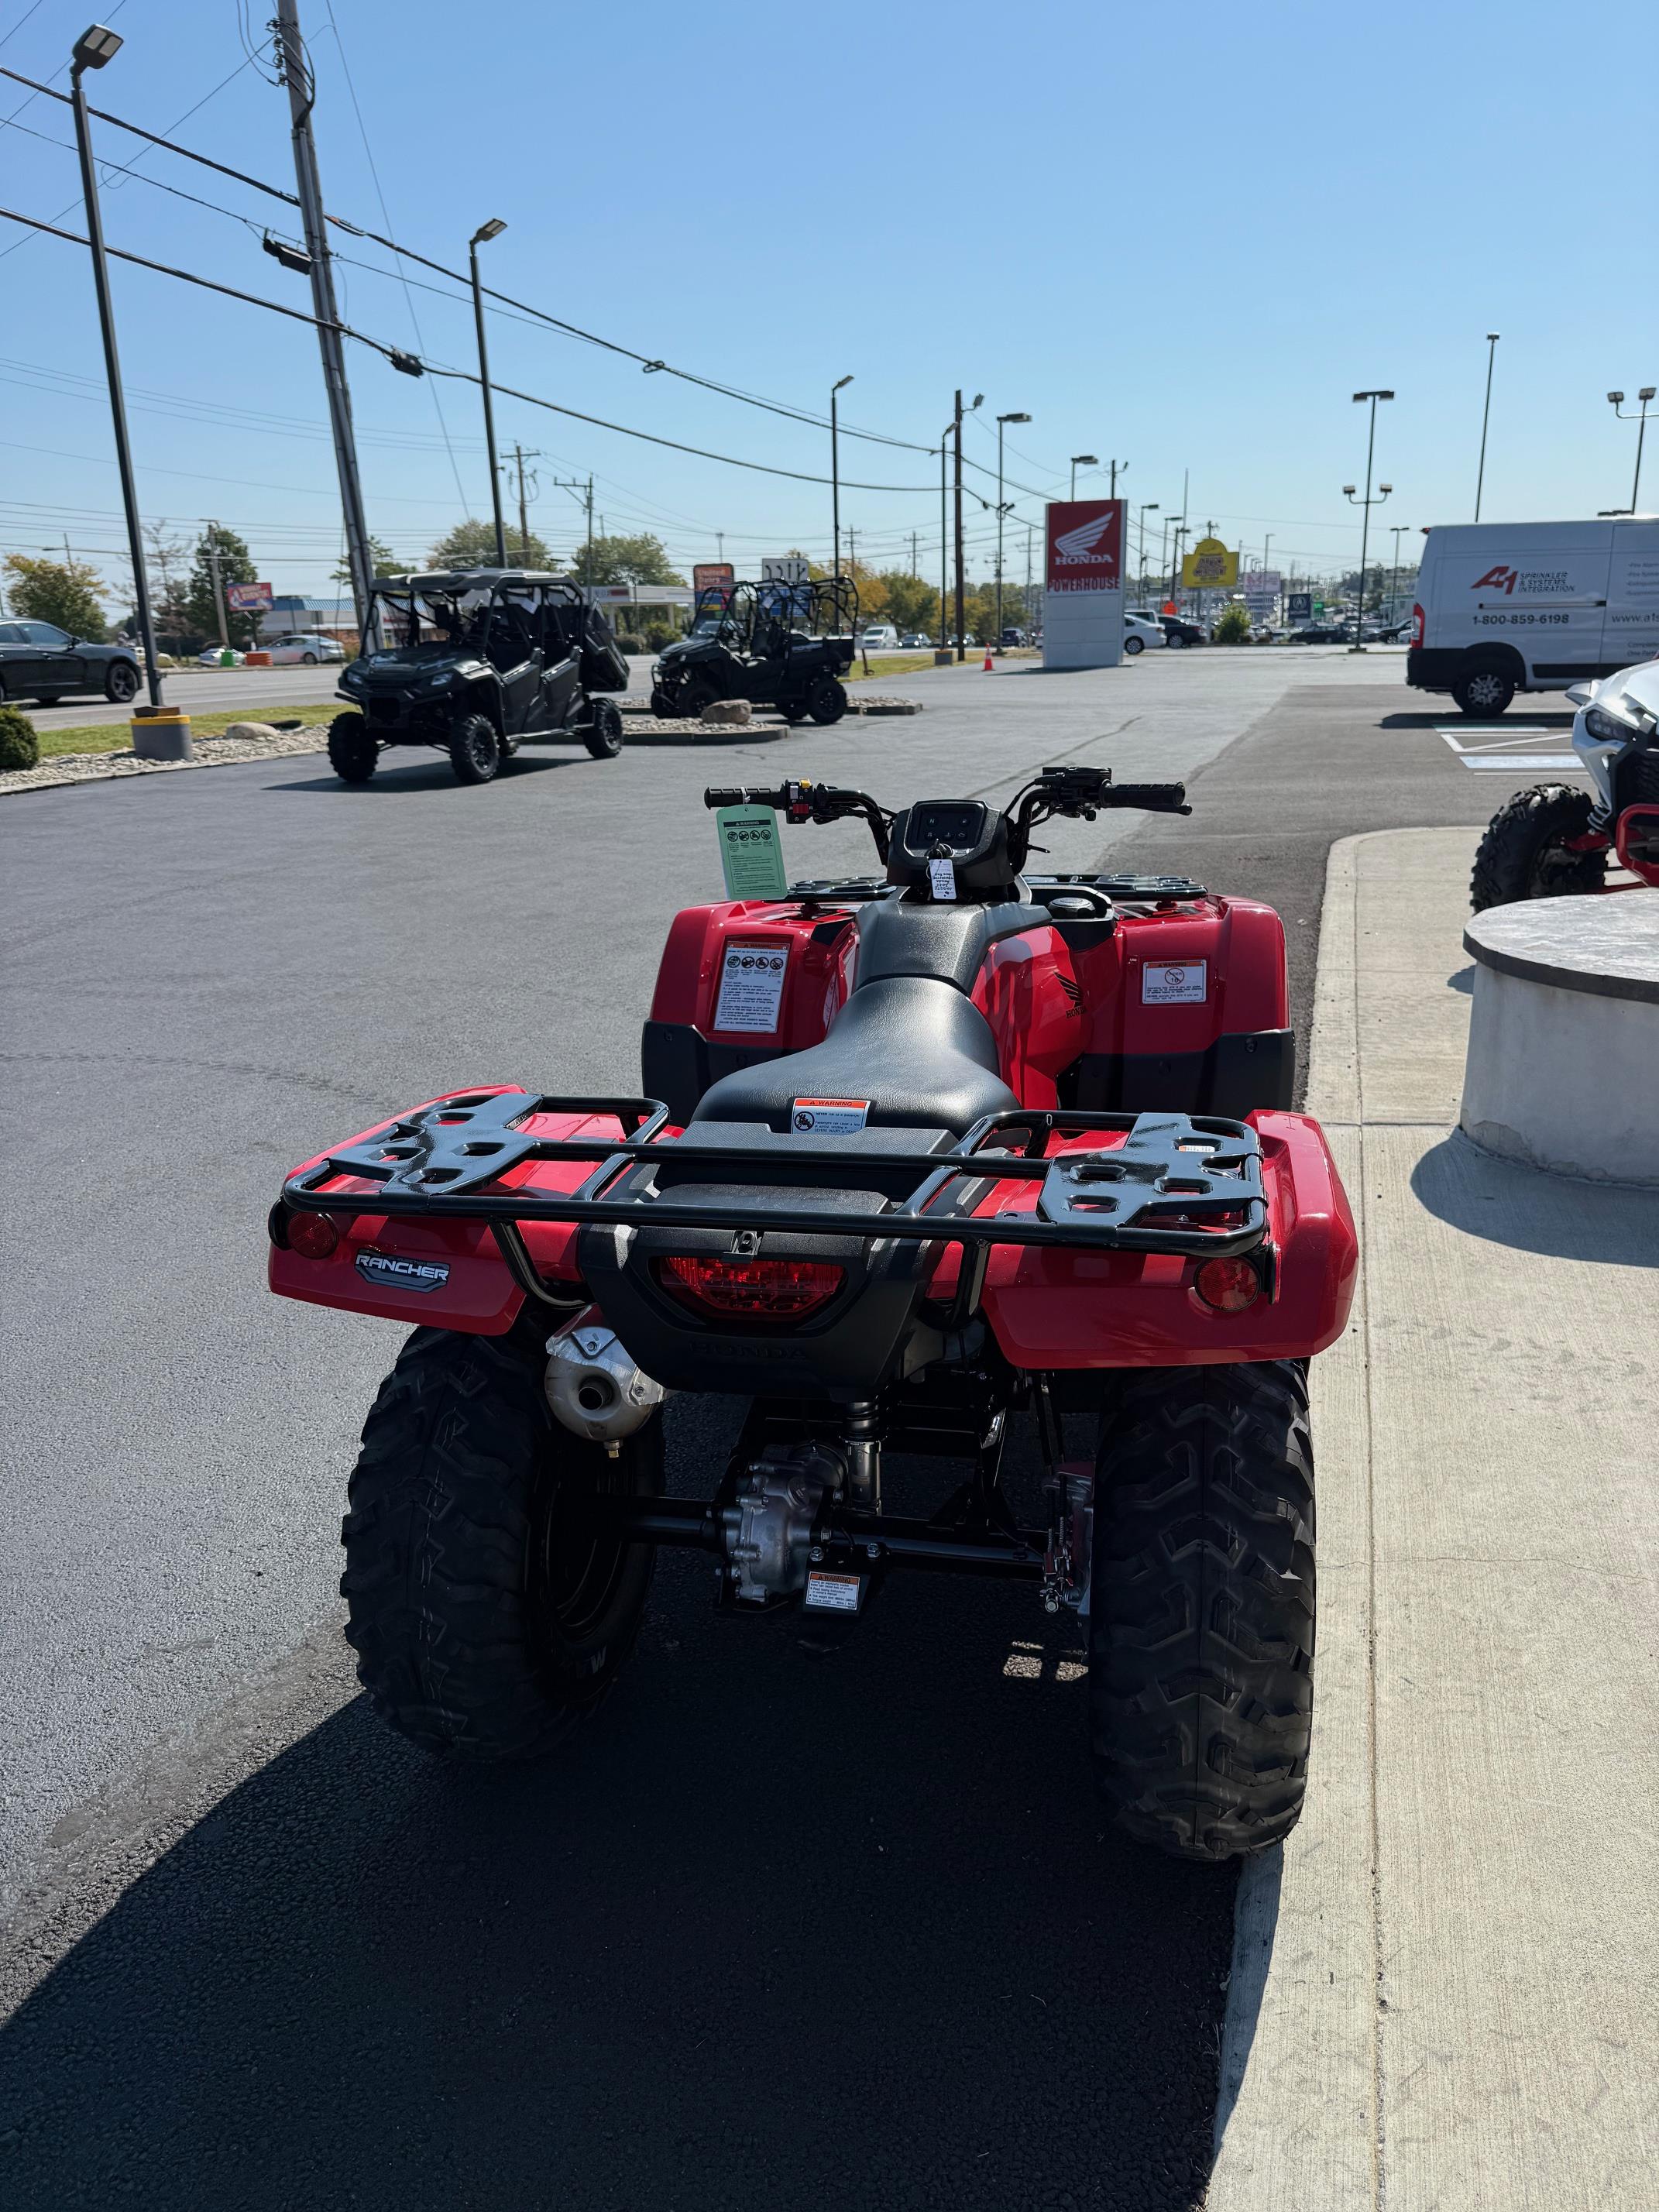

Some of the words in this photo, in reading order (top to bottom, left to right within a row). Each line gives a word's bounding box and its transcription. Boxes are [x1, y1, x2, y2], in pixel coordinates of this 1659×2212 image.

[1055, 554, 1114, 565] HONDA
[1046, 576, 1120, 592] POWERHOUSE
[1473, 614, 1570, 625] 1-800-859-6198
[356, 1254, 449, 1281] RANCHER
[822, 1575, 850, 1584] WARNING
